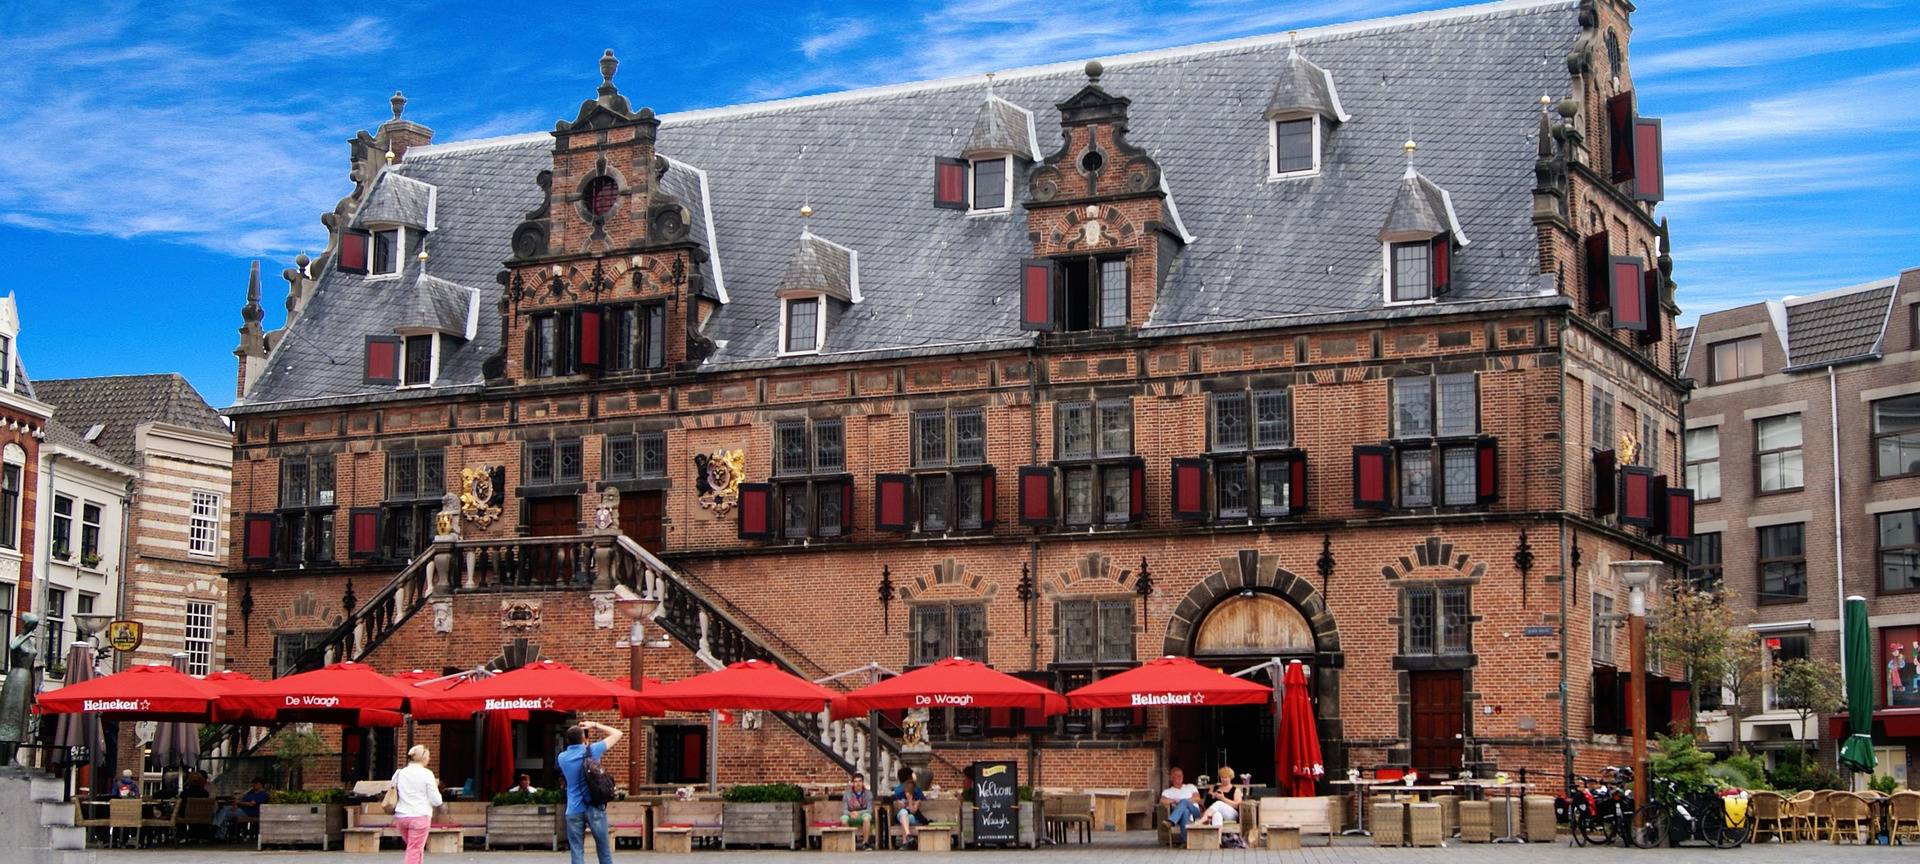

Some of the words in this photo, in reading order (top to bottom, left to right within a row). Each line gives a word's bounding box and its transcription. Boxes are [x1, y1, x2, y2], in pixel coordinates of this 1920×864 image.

[285, 696, 300, 706] De
[302, 695, 339, 707] Waagh
[485, 697, 542, 710] Heineken
[916, 695, 931, 705] De
[934, 694, 974, 706] Waagh
[1131, 692, 1192, 705] Heineken
[83, 699, 139, 711] Heineken
[977, 780, 1014, 797] Welkom
